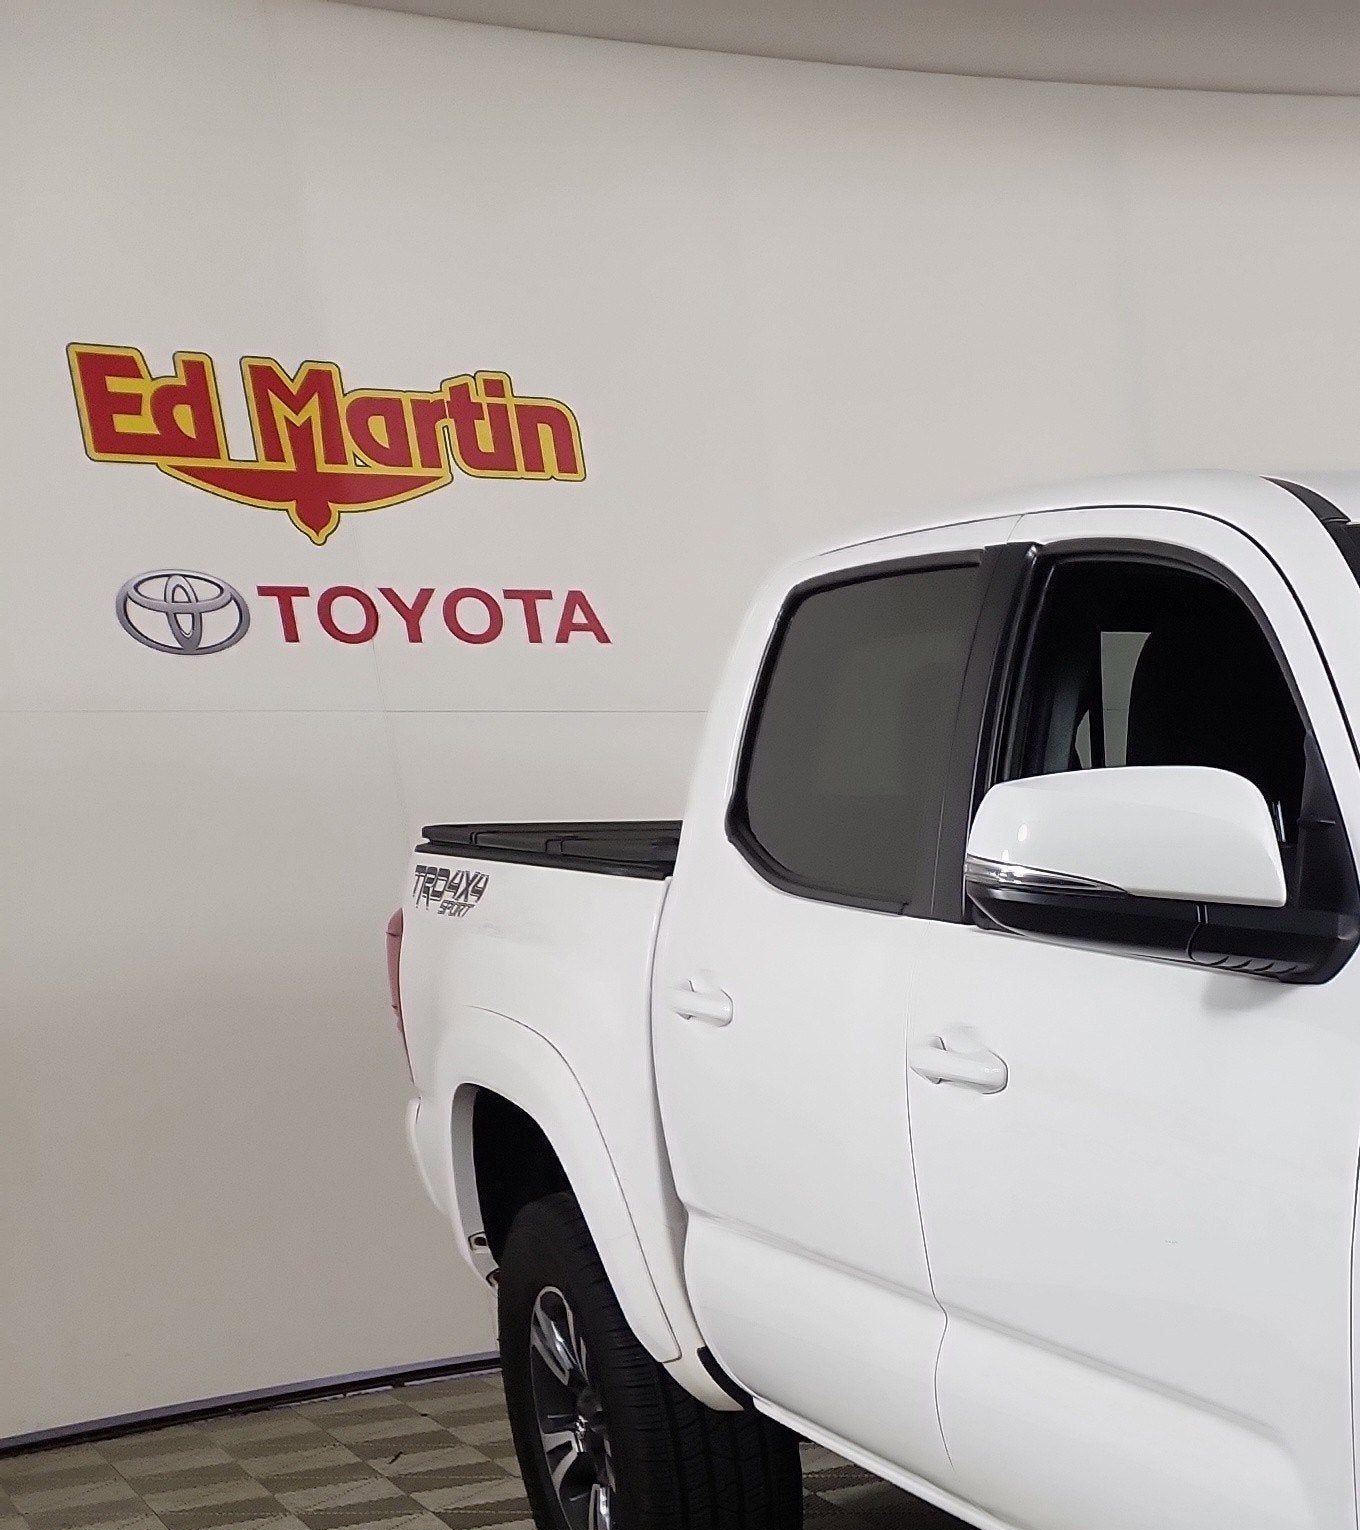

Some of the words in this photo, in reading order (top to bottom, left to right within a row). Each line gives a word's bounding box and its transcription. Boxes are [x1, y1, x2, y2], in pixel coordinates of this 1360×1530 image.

[67, 342, 229, 462] Ed
[241, 356, 586, 480] Martin
[256, 585, 612, 645] TOYOTA
